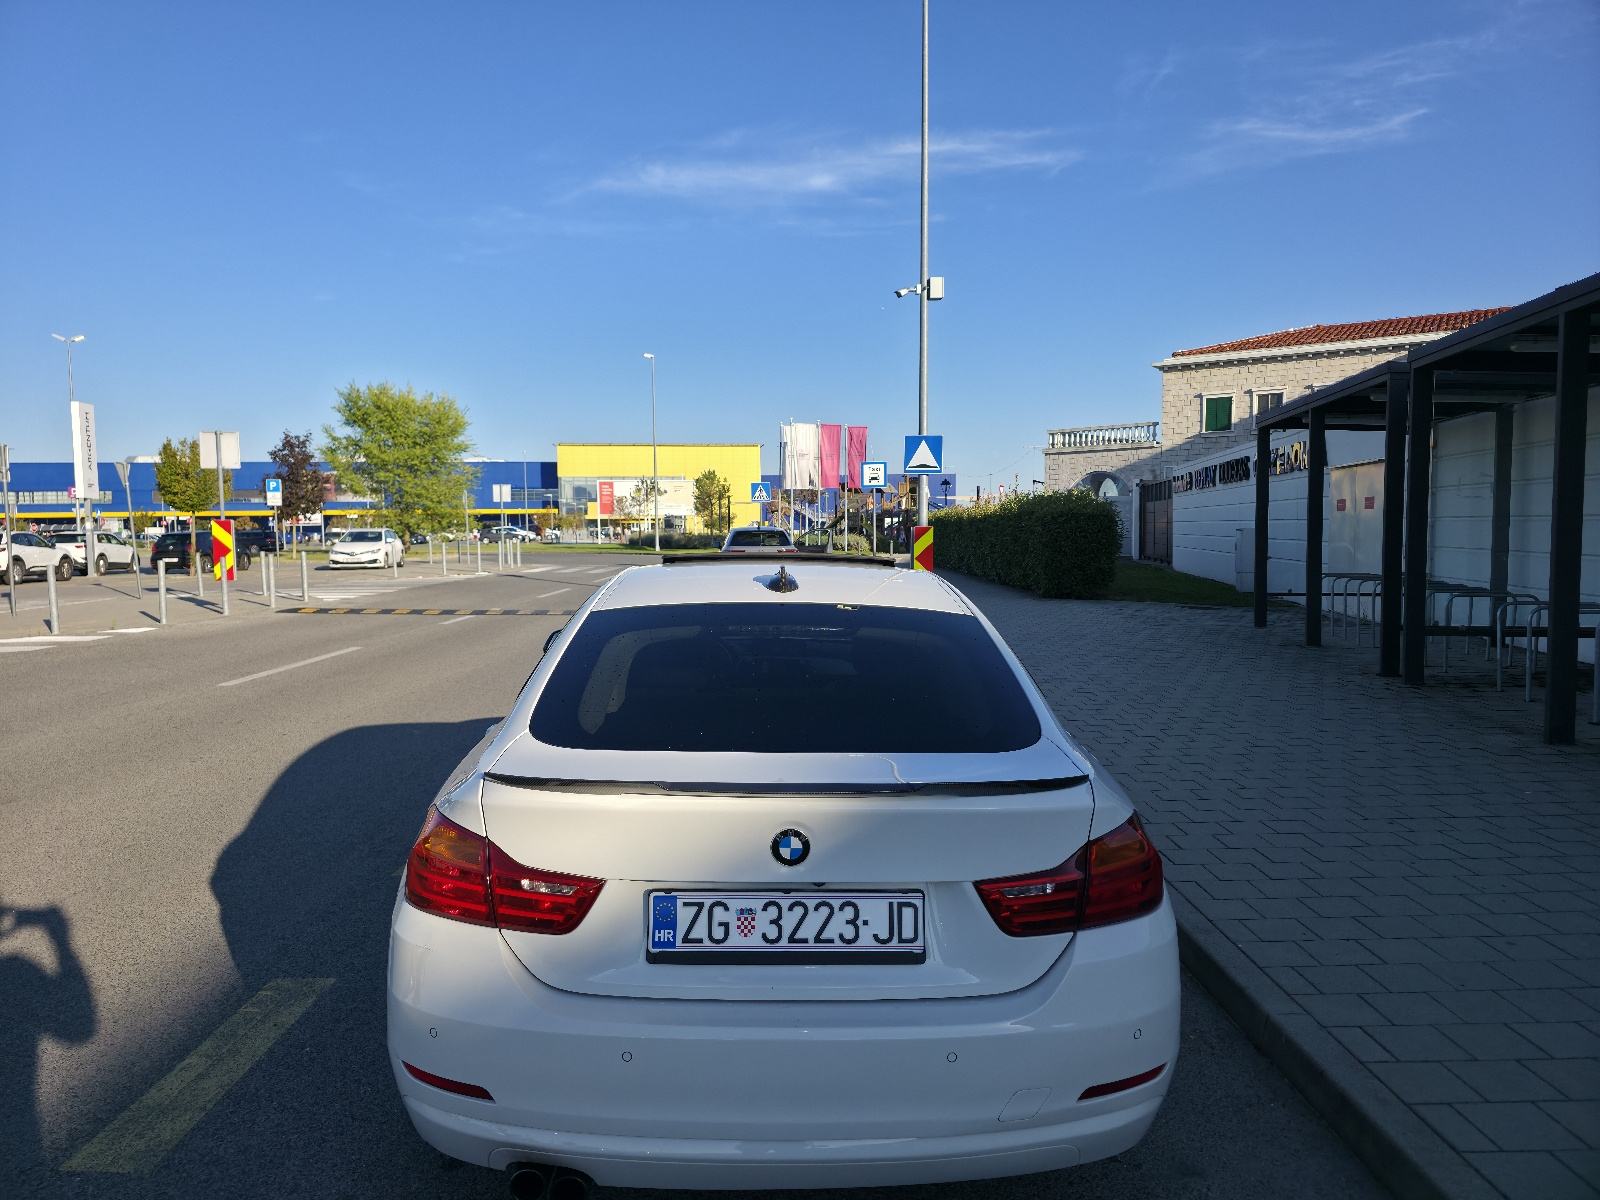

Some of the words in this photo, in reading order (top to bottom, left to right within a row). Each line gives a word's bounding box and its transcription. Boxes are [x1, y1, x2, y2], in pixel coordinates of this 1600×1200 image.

[269, 481, 277, 491] P
[681, 901, 730, 944] ZG
[654, 929, 674, 943] HR
